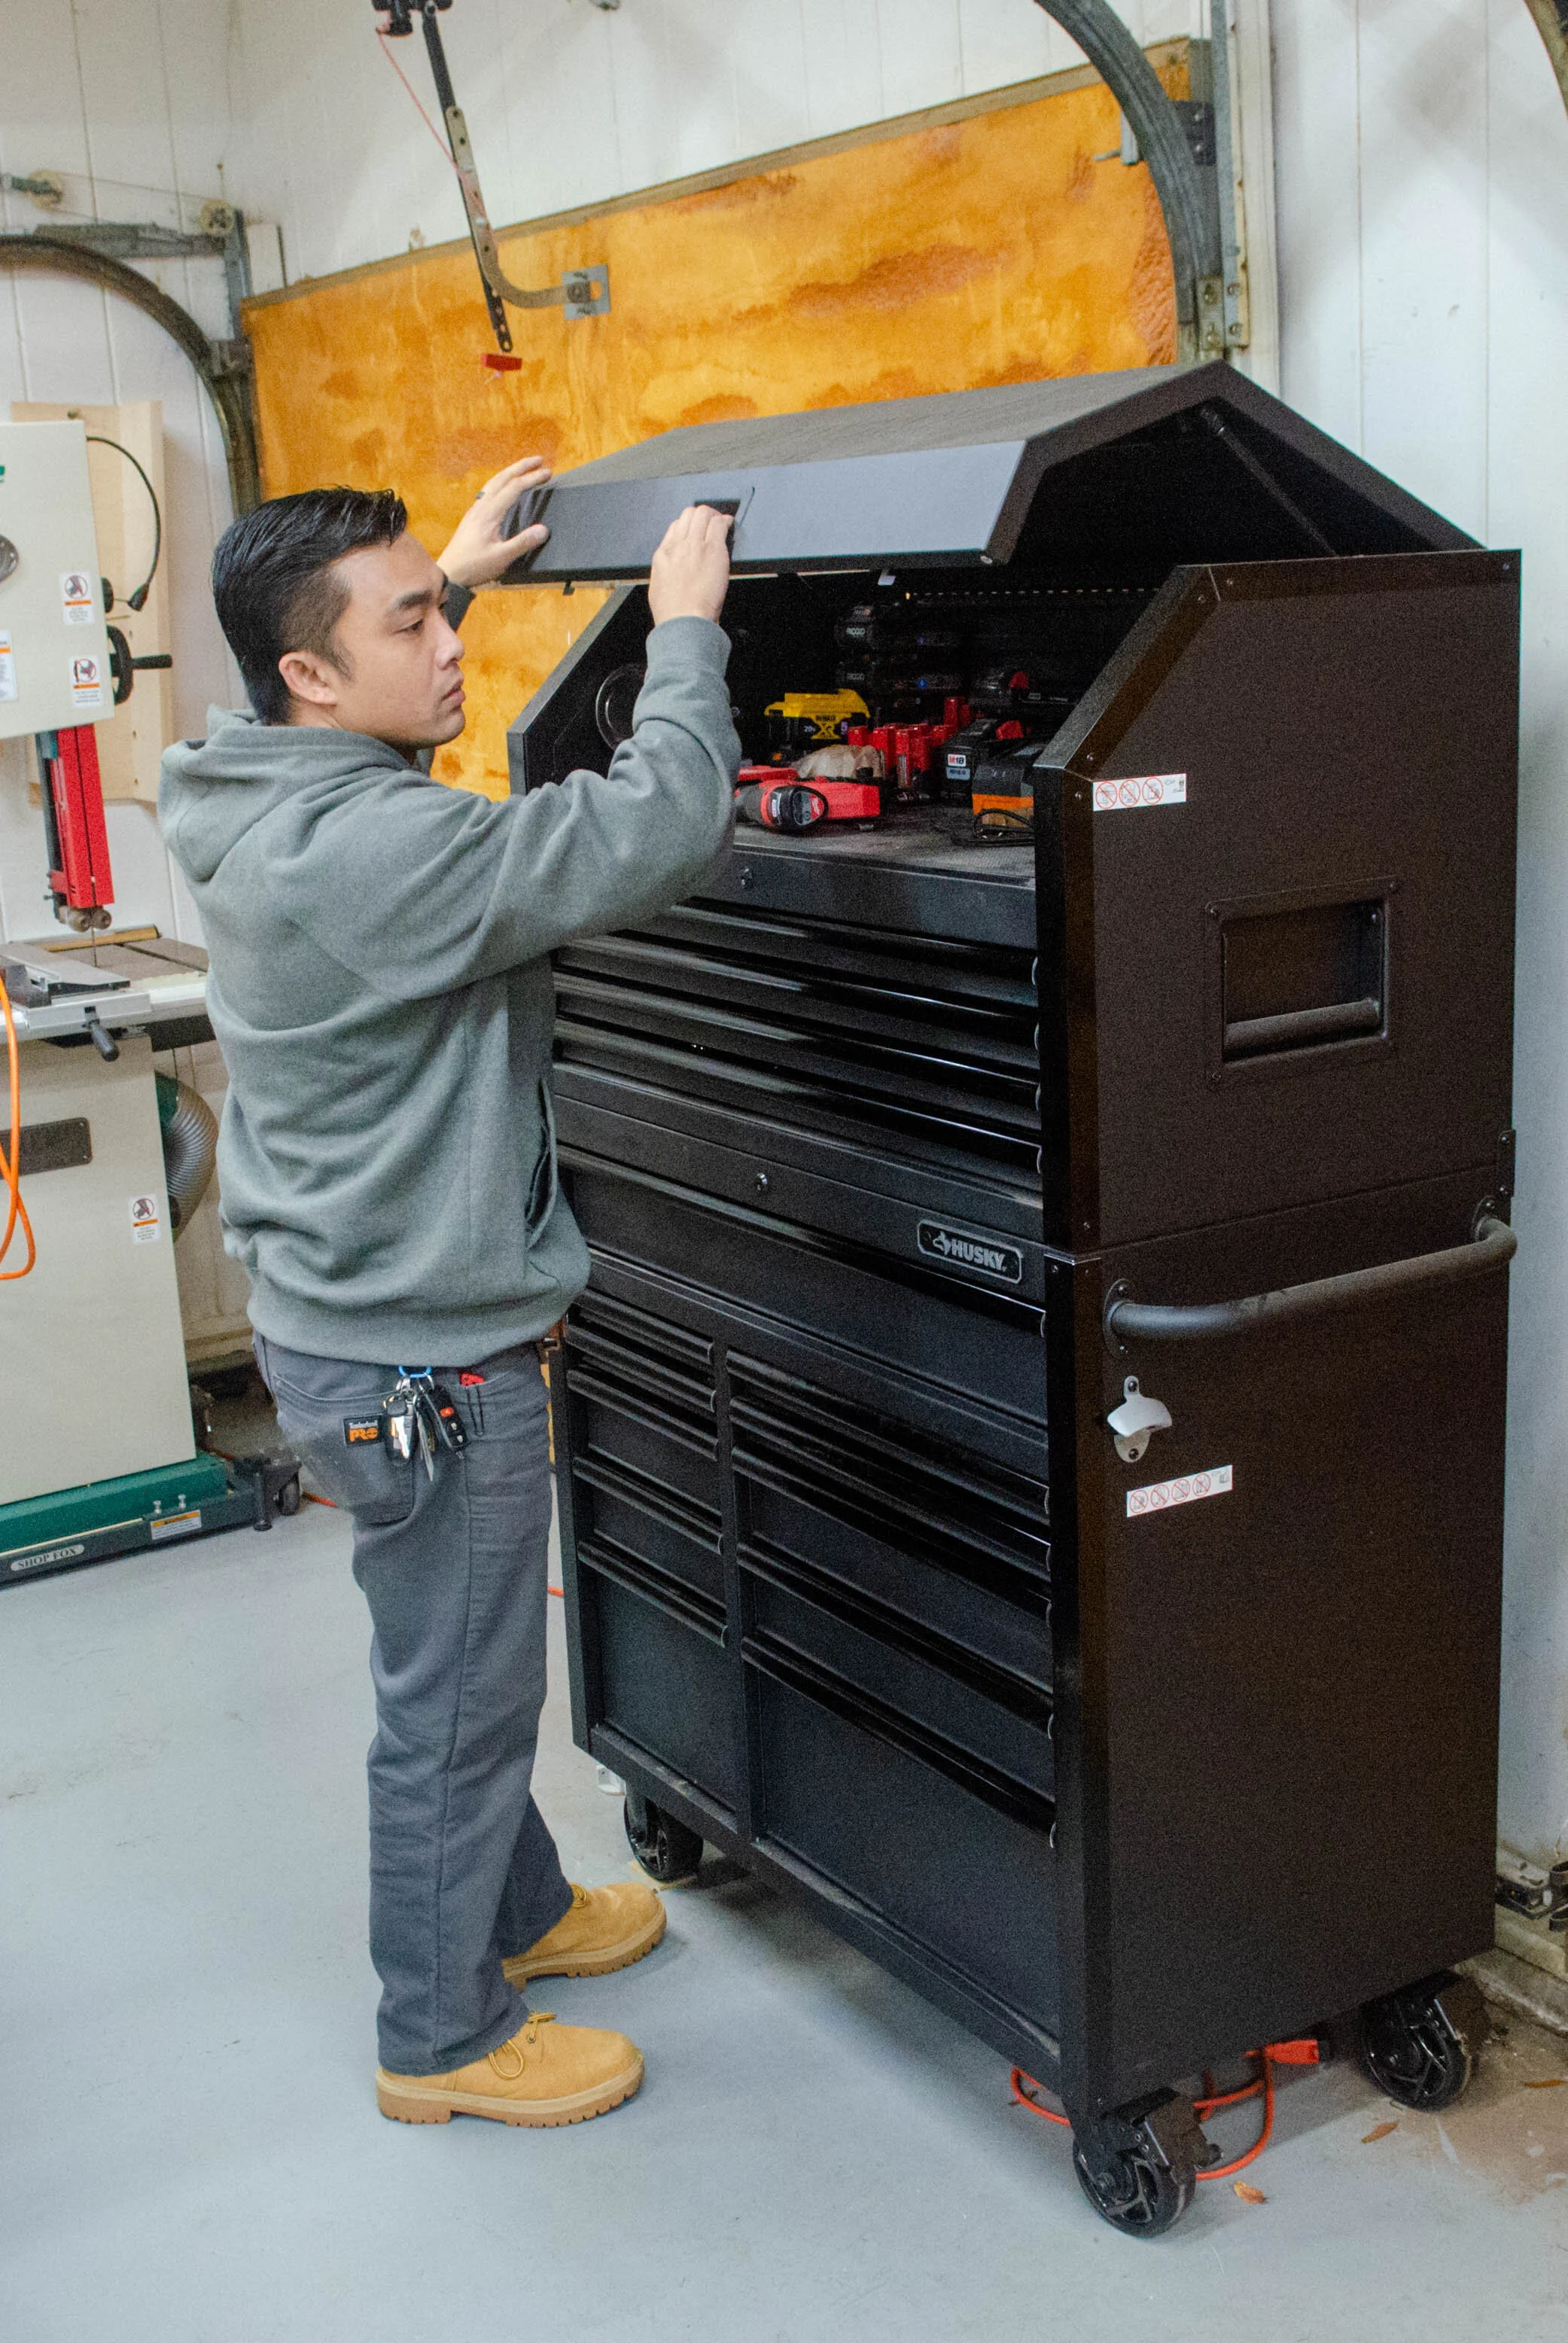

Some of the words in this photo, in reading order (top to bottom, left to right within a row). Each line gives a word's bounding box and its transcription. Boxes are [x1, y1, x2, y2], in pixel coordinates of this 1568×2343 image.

[951, 1238, 1006, 1271] HUSKY
[349, 1427, 379, 1443] PRO
[18, 1555, 49, 1568] SHOP
[53, 1547, 76, 1559] FOX
